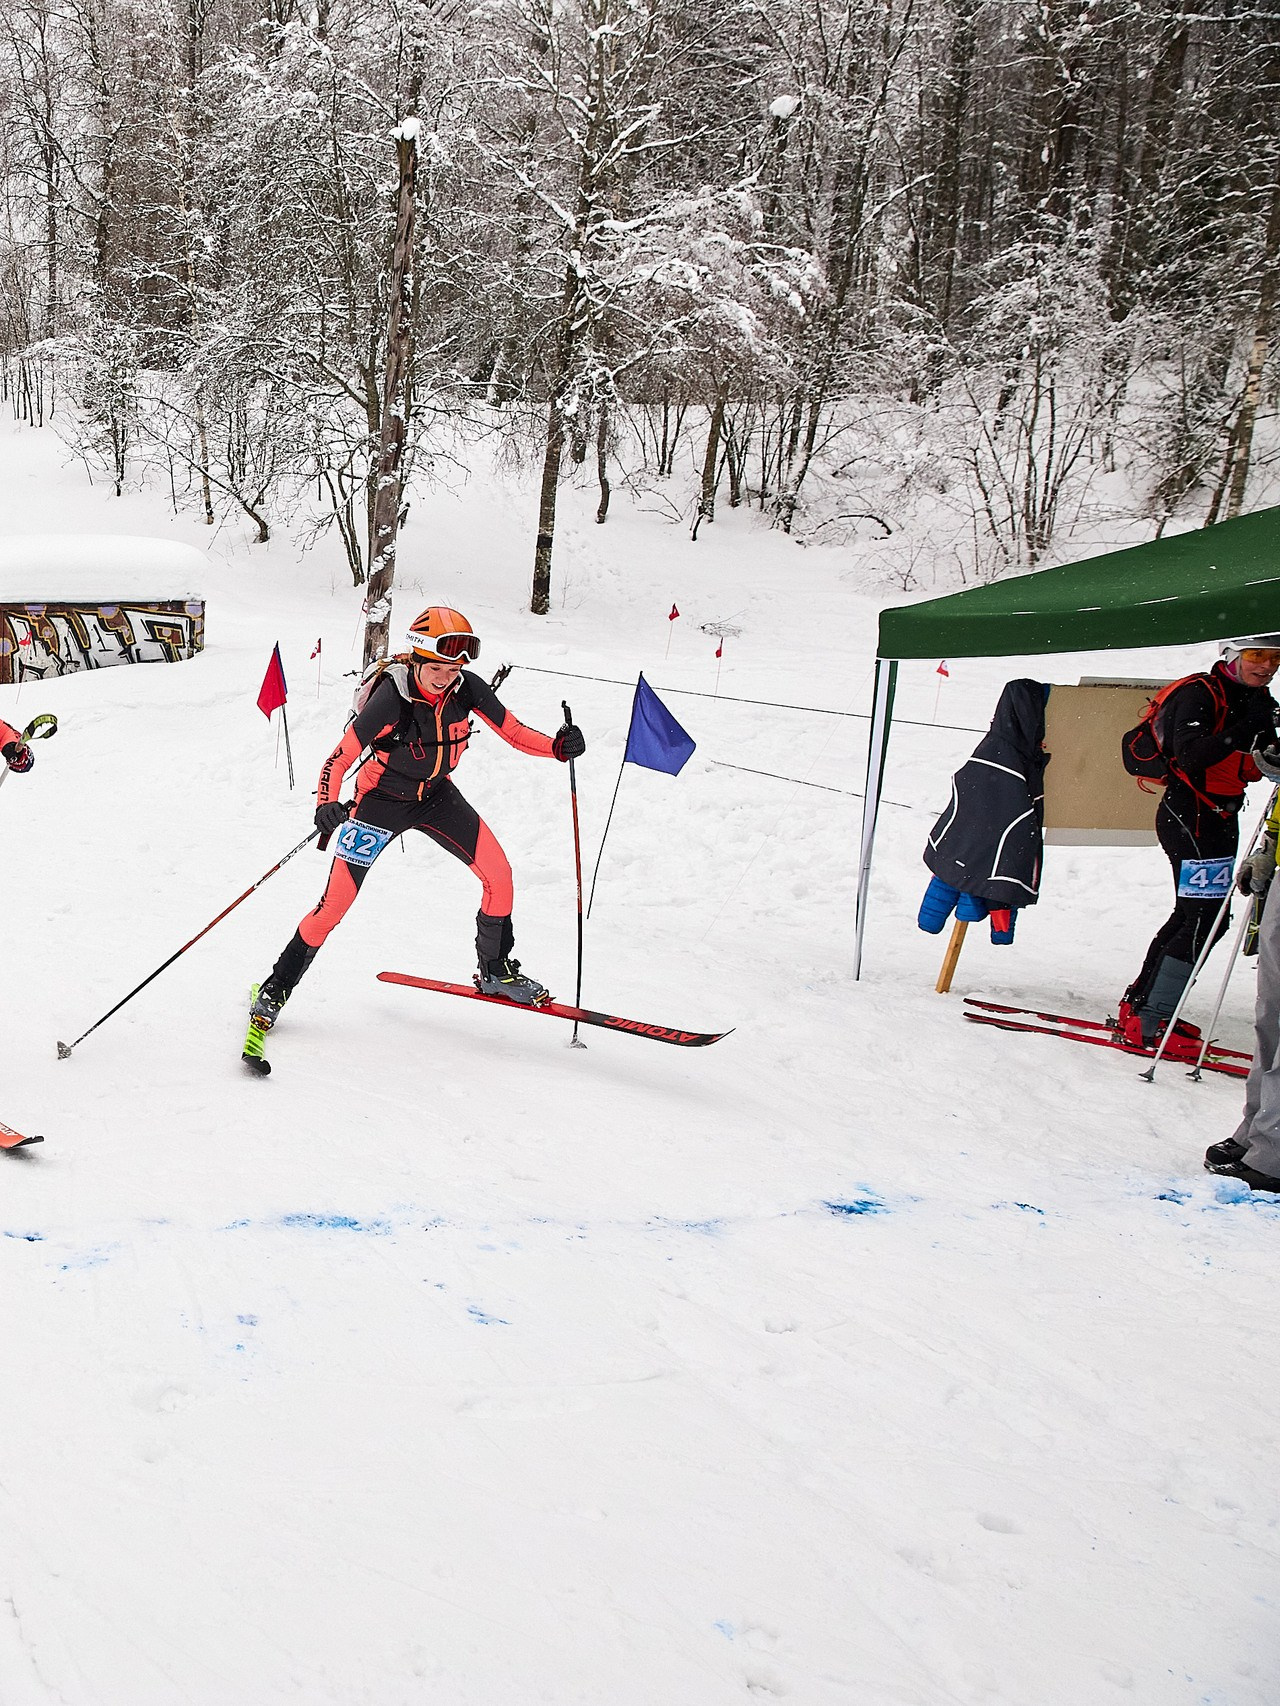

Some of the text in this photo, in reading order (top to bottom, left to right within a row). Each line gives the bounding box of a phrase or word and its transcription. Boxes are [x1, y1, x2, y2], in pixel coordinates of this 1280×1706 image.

[341, 828, 378, 856] 42
[1188, 867, 1230, 888] 44
[603, 1017, 699, 1042] ATOMIC
